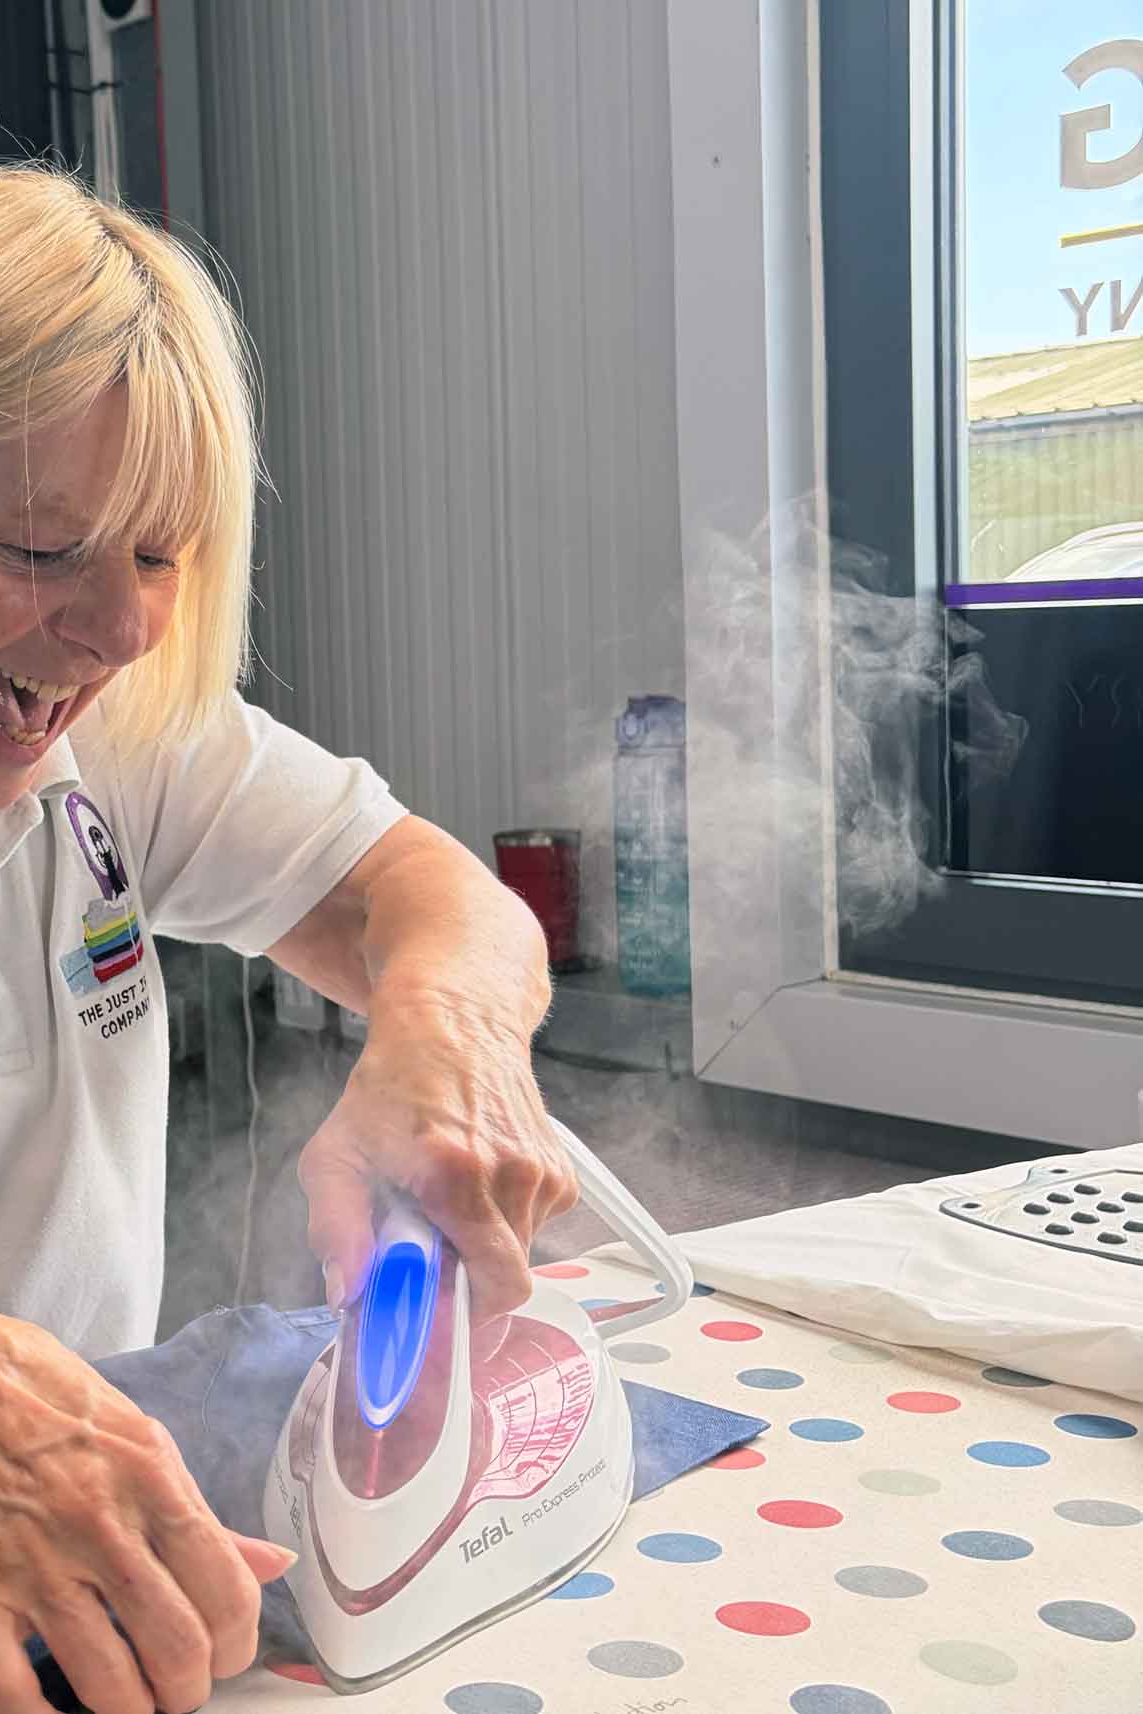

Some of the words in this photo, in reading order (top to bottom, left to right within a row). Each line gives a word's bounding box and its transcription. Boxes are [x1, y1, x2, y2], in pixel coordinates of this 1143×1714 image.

[78, 1003, 104, 1027] THE
[105, 984, 136, 1013] JUST
[101, 996, 150, 1039] COMPAN
[459, 1516, 514, 1563] Tefal
[521, 1508, 543, 1527] Pro
[542, 1482, 580, 1513] Express
